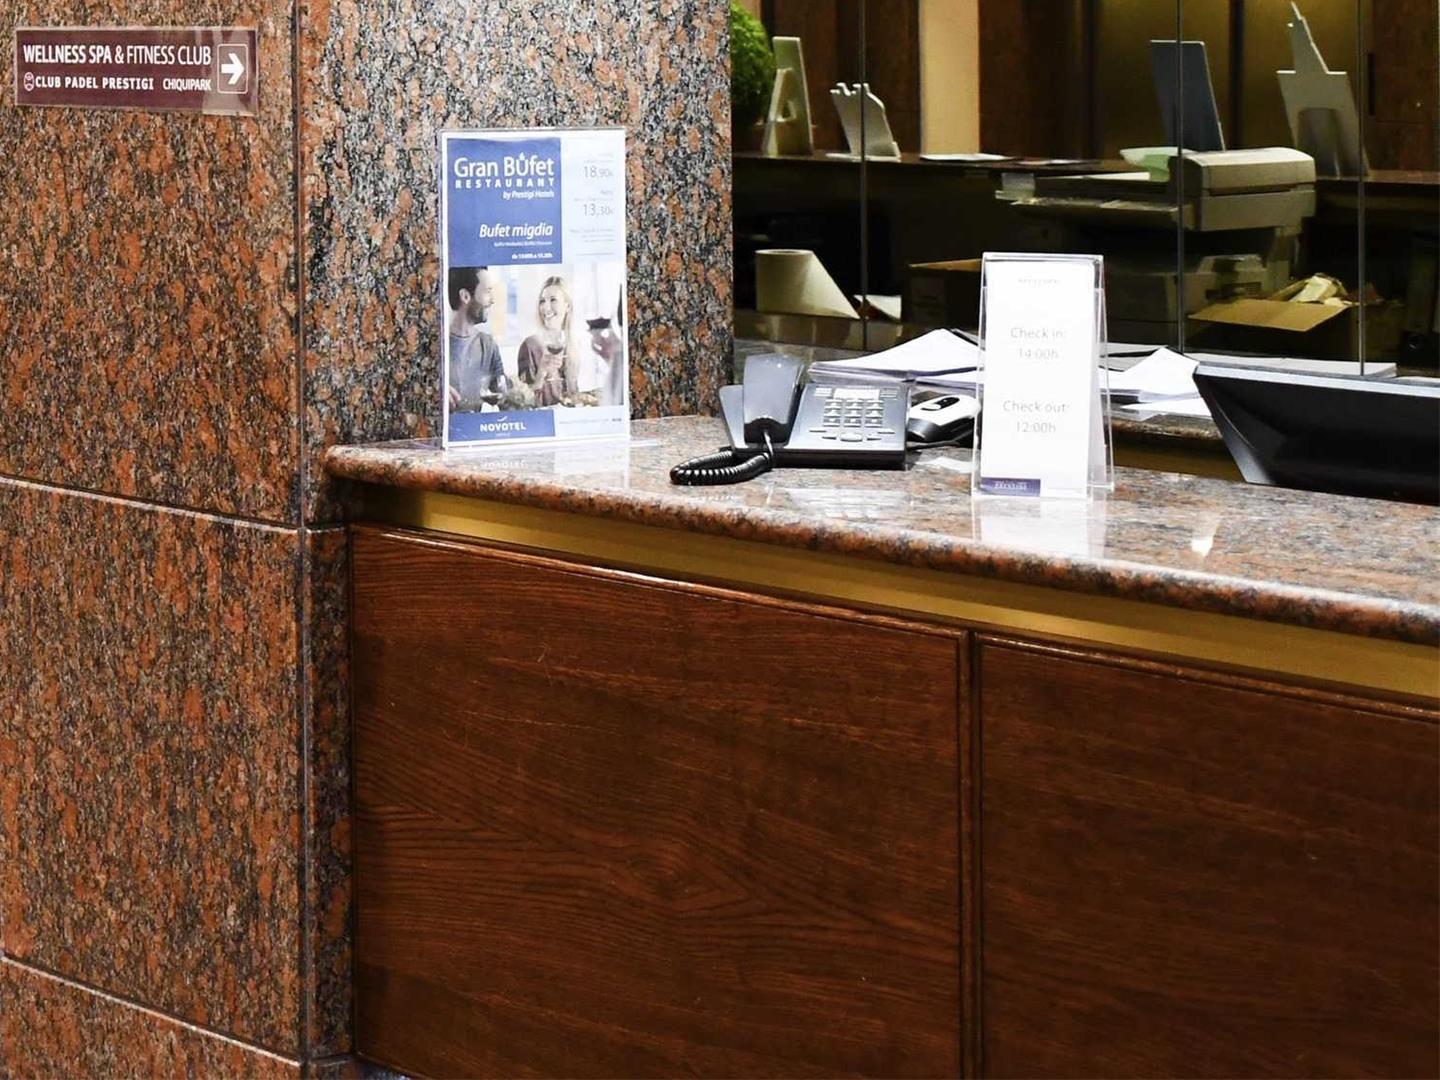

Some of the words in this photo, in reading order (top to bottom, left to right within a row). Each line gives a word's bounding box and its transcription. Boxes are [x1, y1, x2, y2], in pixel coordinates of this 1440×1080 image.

[23, 44, 86, 64] WELLNESS
[89, 45, 112, 64] SPA
[114, 45, 125, 64] &
[126, 45, 175, 65] FITNESS
[177, 45, 211, 66] CLUB
[35, 77, 61, 89] CLUB
[65, 77, 98, 89] PADEL
[102, 78, 154, 90] PRESTIGI
[163, 78, 212, 91] CHIQUIPARK
[454, 157, 498, 177] Gran
[455, 178, 555, 189] RESTAURANT
[479, 223, 510, 238] Bufet
[511, 222, 553, 240] migdia
[1010, 327, 1049, 339] Check
[1003, 400, 1040, 413] Check
[480, 422, 527, 432] NOVOTEL
